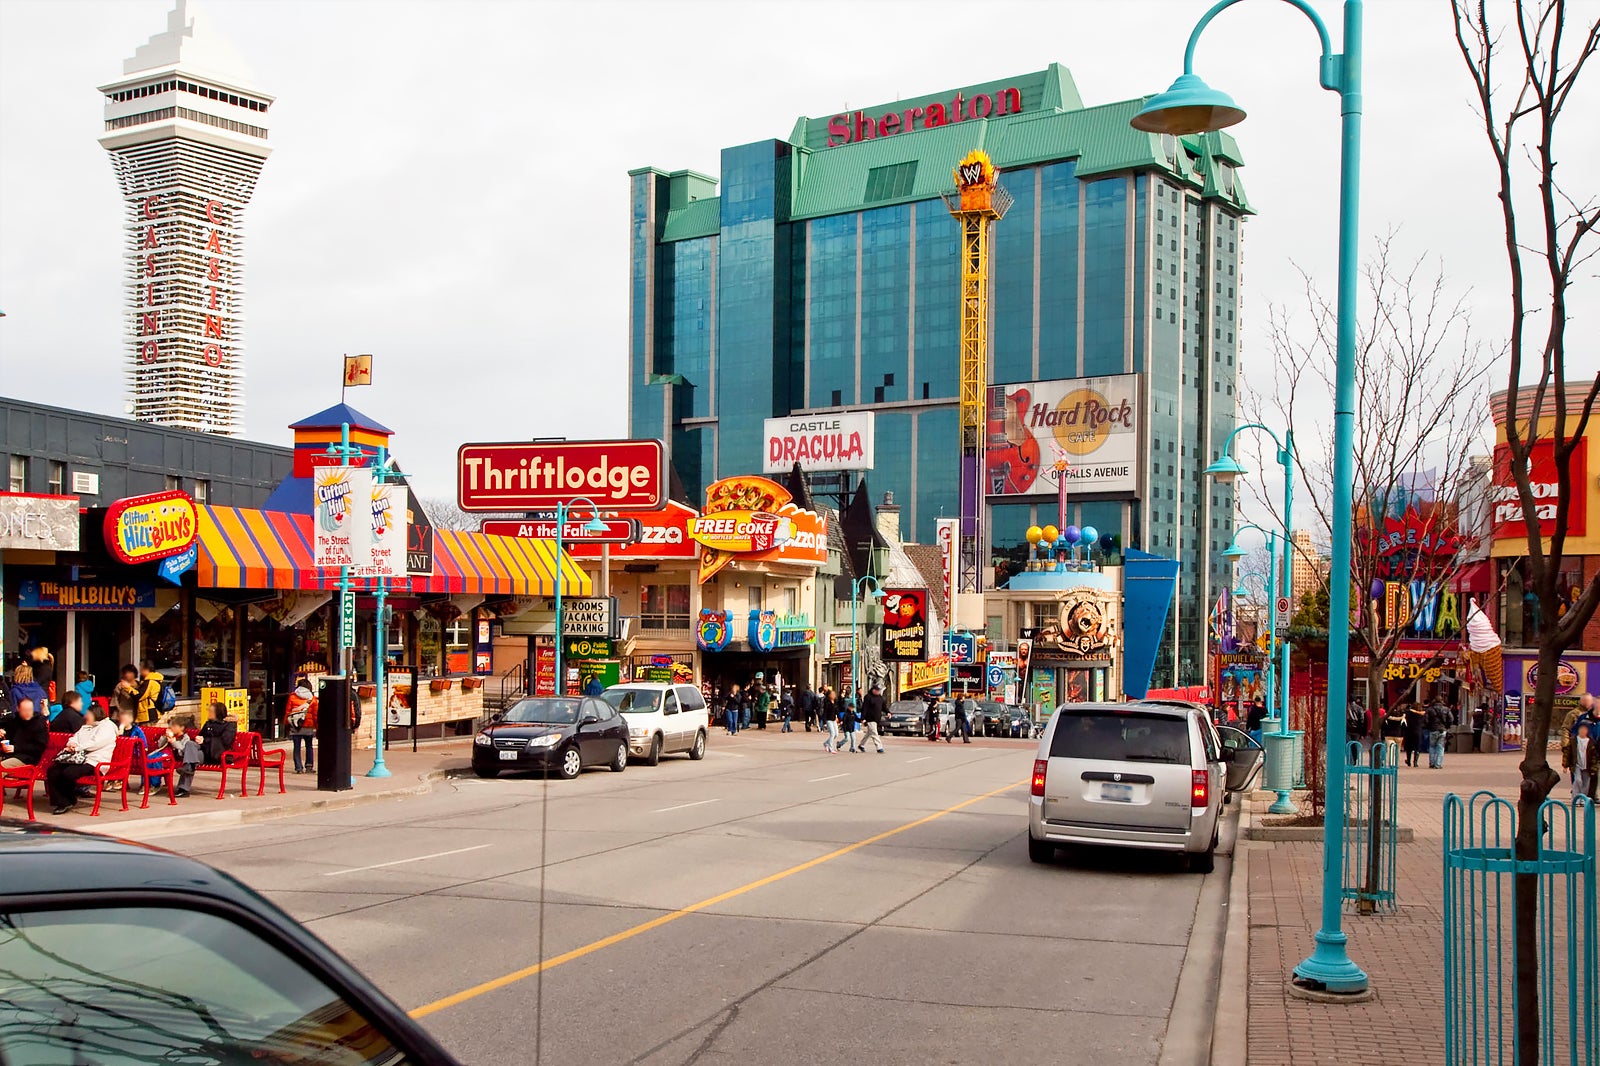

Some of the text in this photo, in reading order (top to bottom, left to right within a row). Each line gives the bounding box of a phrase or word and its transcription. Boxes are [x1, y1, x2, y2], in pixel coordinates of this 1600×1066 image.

[826, 86, 1022, 147] Sheraton
[141, 195, 160, 364] CASINO
[203, 200, 223, 367] CASINO
[1030, 398, 1132, 429] Hard Rock
[790, 421, 840, 432] CASTLE
[769, 431, 863, 467] DRACULA
[465, 455, 650, 499] Thriftlodge
[1066, 468, 1091, 479] FALLS
[1093, 466, 1129, 477] AVENUE
[318, 481, 350, 502] Clifton
[327, 496, 346, 516] Hill
[123, 511, 149, 526] Clifton
[518, 524, 594, 537] At the Fall
[694, 519, 774, 534] FREE COKE
[318, 536, 350, 545] The Street
[325, 546, 344, 555] of fun
[371, 548, 391, 557] Street
[318, 554, 352, 565] at the Falls
[373, 557, 384, 566] fun
[365, 566, 377, 575] the
[378, 566, 392, 575] Falls
[40, 582, 137, 606] THE HILLBILLY'S
[343, 595, 353, 615] PAY
[571, 602, 603, 611] ROOMS
[564, 623, 604, 632] PARKING
[894, 639, 922, 649] Haunted
[591, 648, 609, 656] Parking
[1383, 663, 1405, 680] Hot
